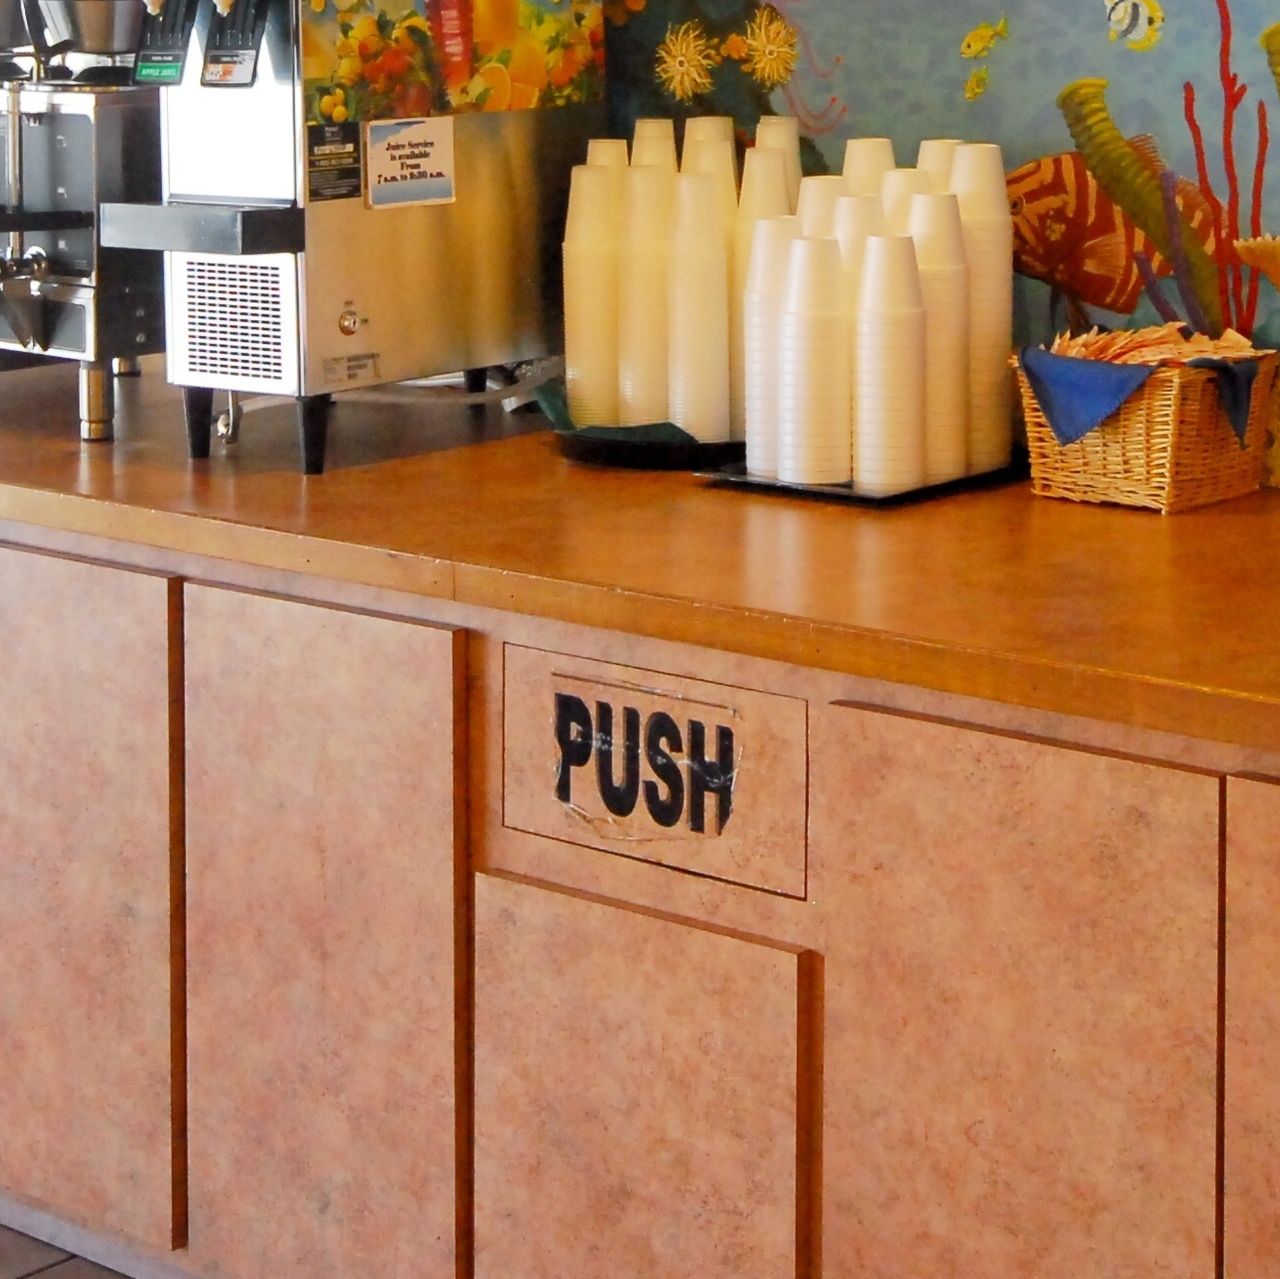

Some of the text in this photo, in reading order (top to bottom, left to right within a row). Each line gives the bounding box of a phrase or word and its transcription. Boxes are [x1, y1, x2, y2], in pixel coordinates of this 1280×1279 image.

[386, 140, 434, 151] Juice Service
[398, 150, 430, 161] available
[401, 162, 421, 171] From
[553, 693, 735, 836] PUSH
